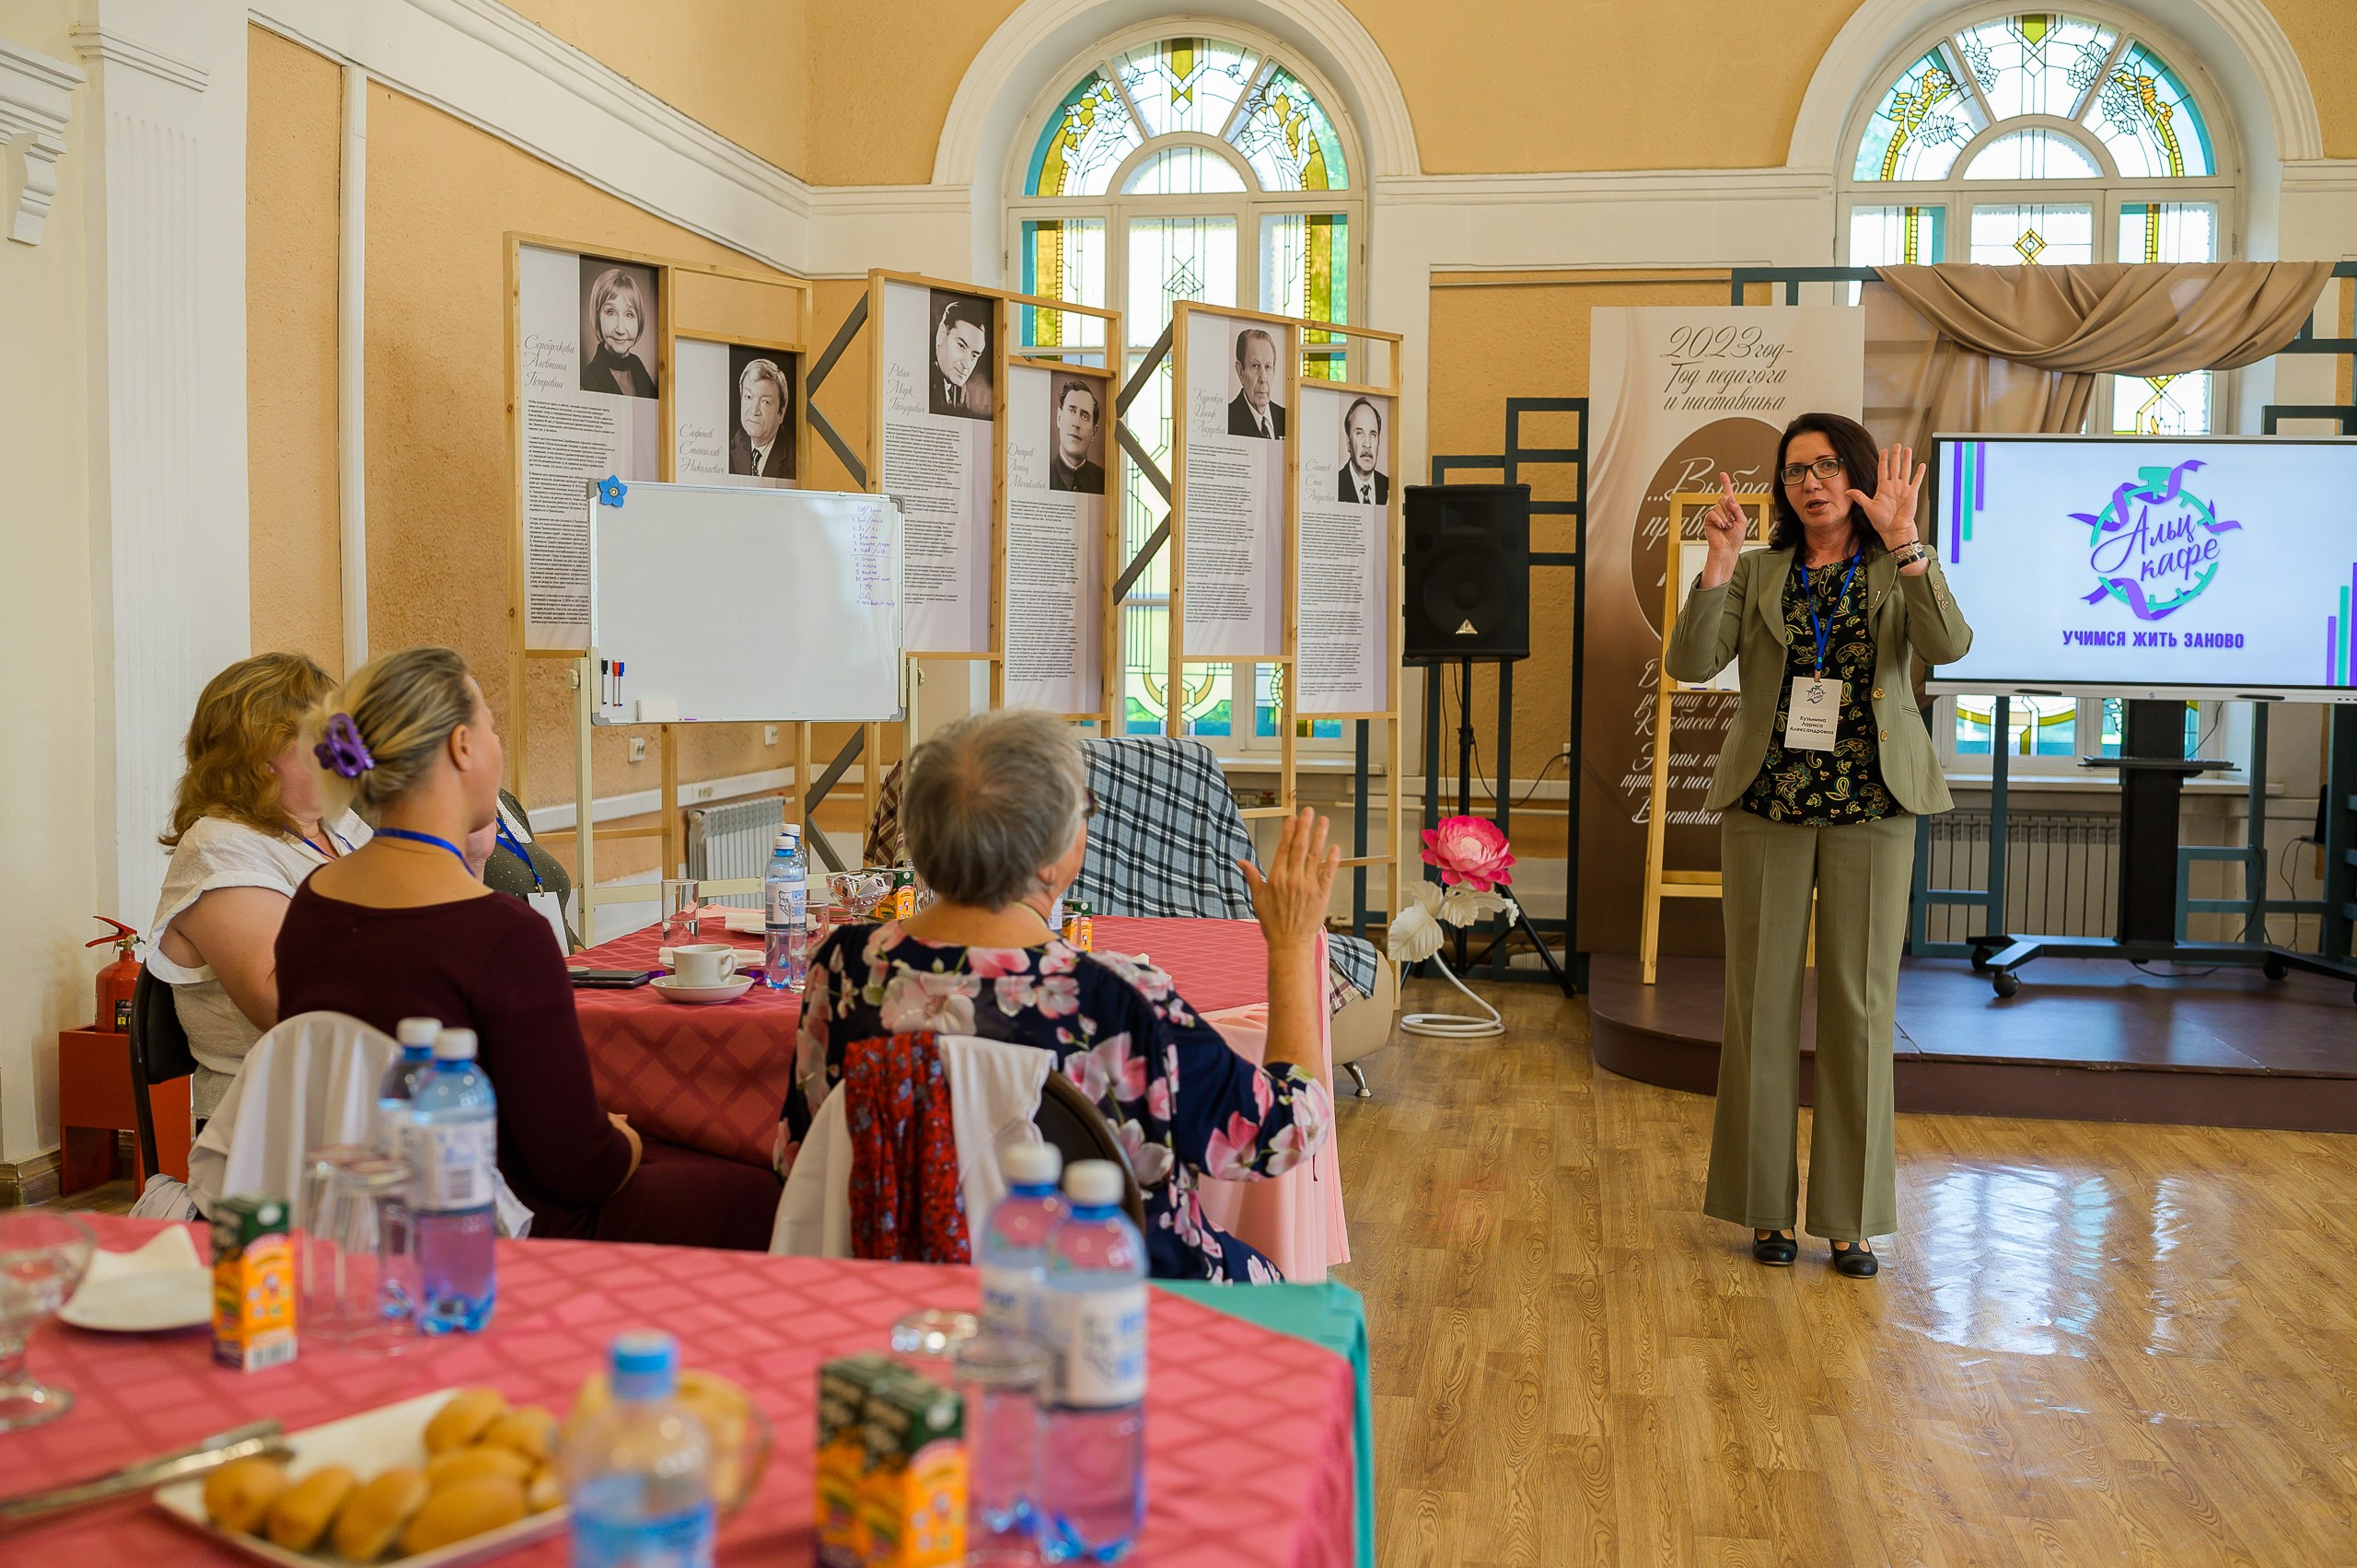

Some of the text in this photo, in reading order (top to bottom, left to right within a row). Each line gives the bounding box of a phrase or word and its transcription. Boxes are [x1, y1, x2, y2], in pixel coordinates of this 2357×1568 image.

[523, 352, 567, 370] Алевтина
[525, 371, 563, 392] Петровна
[1664, 361, 1787, 394] Год педагога
[886, 379, 914, 400] Марк
[1664, 387, 1786, 411] и наставника
[679, 440, 722, 457] Станислав
[2091, 505, 2196, 574] Альц
[2140, 539, 2221, 582] кафе
[2062, 630, 2245, 649] УЧИМСЯ ЖИТЬ ЗАНОВО
[1789, 726, 1834, 735] Александровна
[1632, 741, 1700, 771] Эапы
